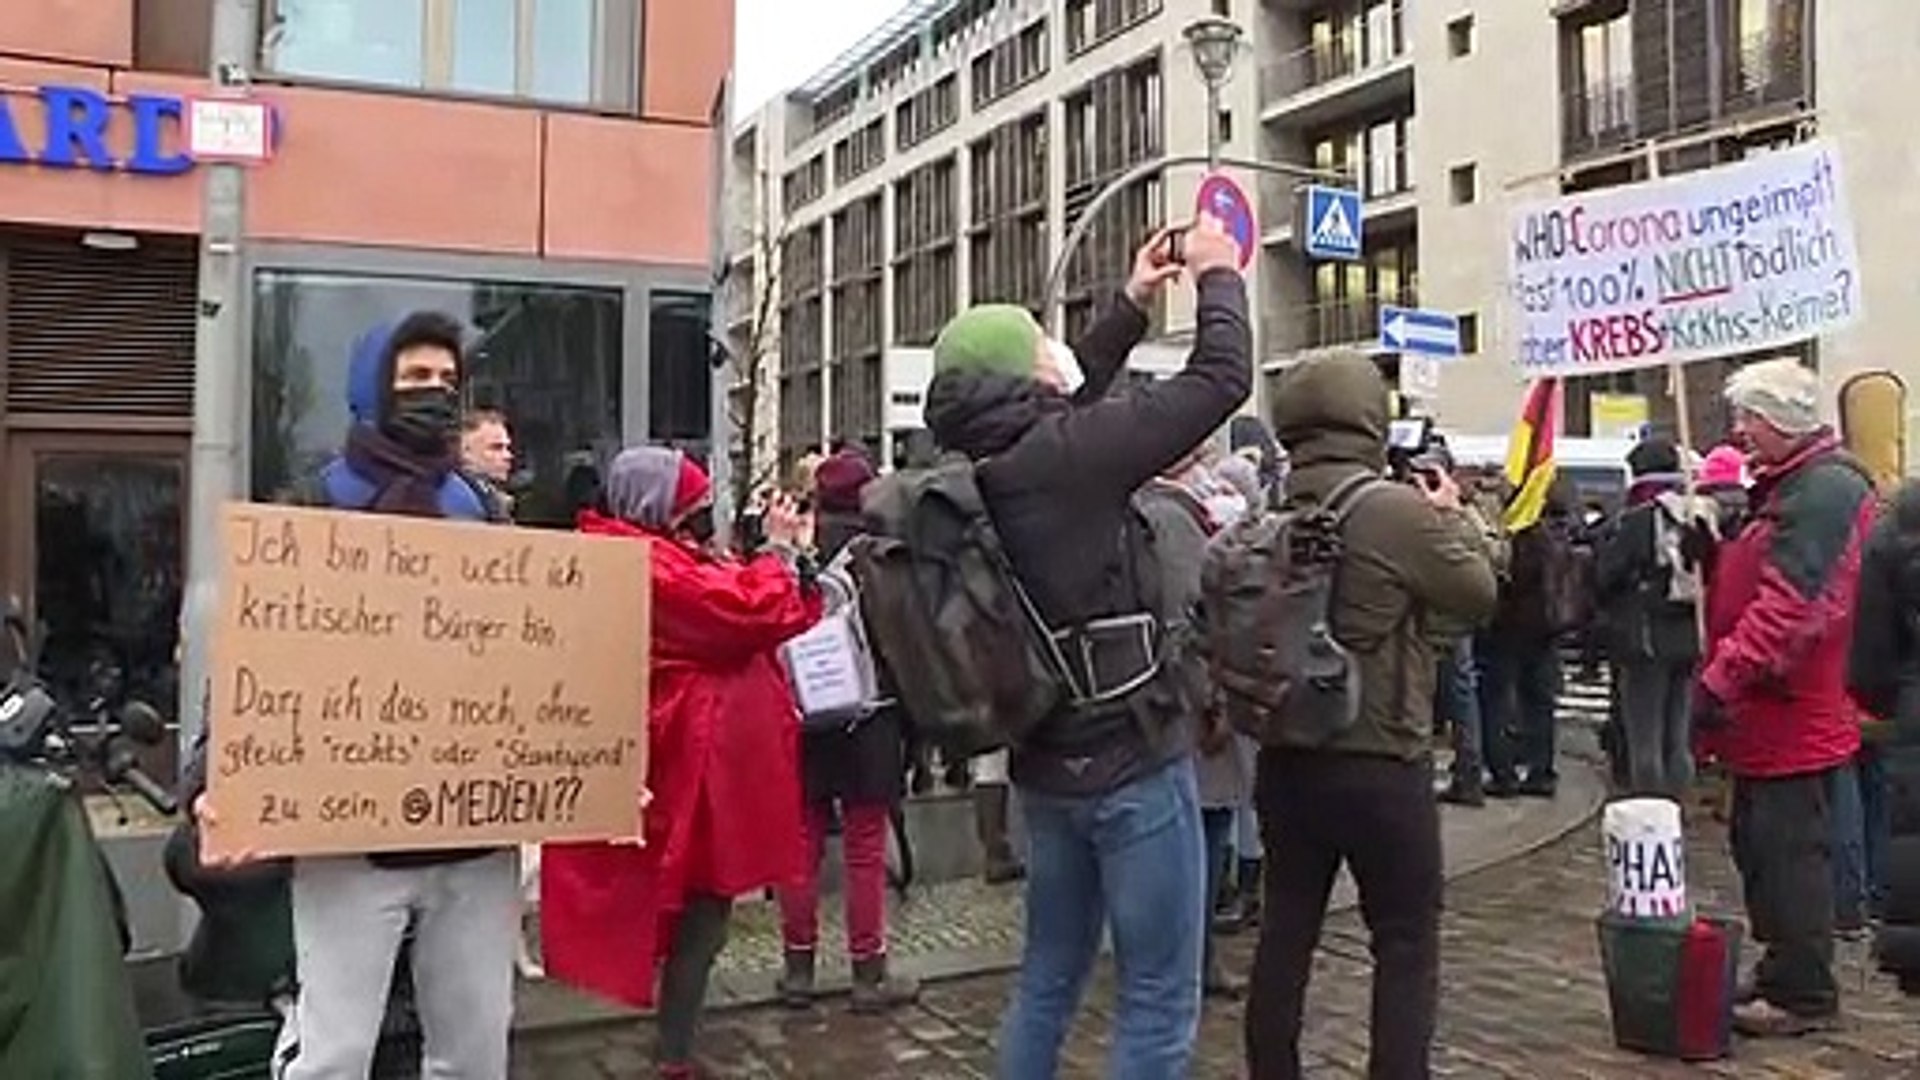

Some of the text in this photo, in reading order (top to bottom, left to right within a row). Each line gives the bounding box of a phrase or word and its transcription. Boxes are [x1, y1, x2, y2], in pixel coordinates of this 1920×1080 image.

[1569, 206, 1682, 255] Corona
[1561, 258, 1645, 310] 100%
[1653, 242, 1733, 294] NICHT
[326, 521, 370, 571] bin
[461, 545, 534, 587] weil
[548, 555, 584, 590] ich
[239, 584, 401, 635] kritischer
[423, 597, 508, 657] Bürger
[233, 666, 303, 742] Darf
[321, 675, 363, 722] ich
[378, 679, 429, 724] das
[536, 682, 594, 728] ohne
[218, 733, 305, 777] gleich
[430, 743, 481, 765] oder
[259, 794, 301, 827] zu
